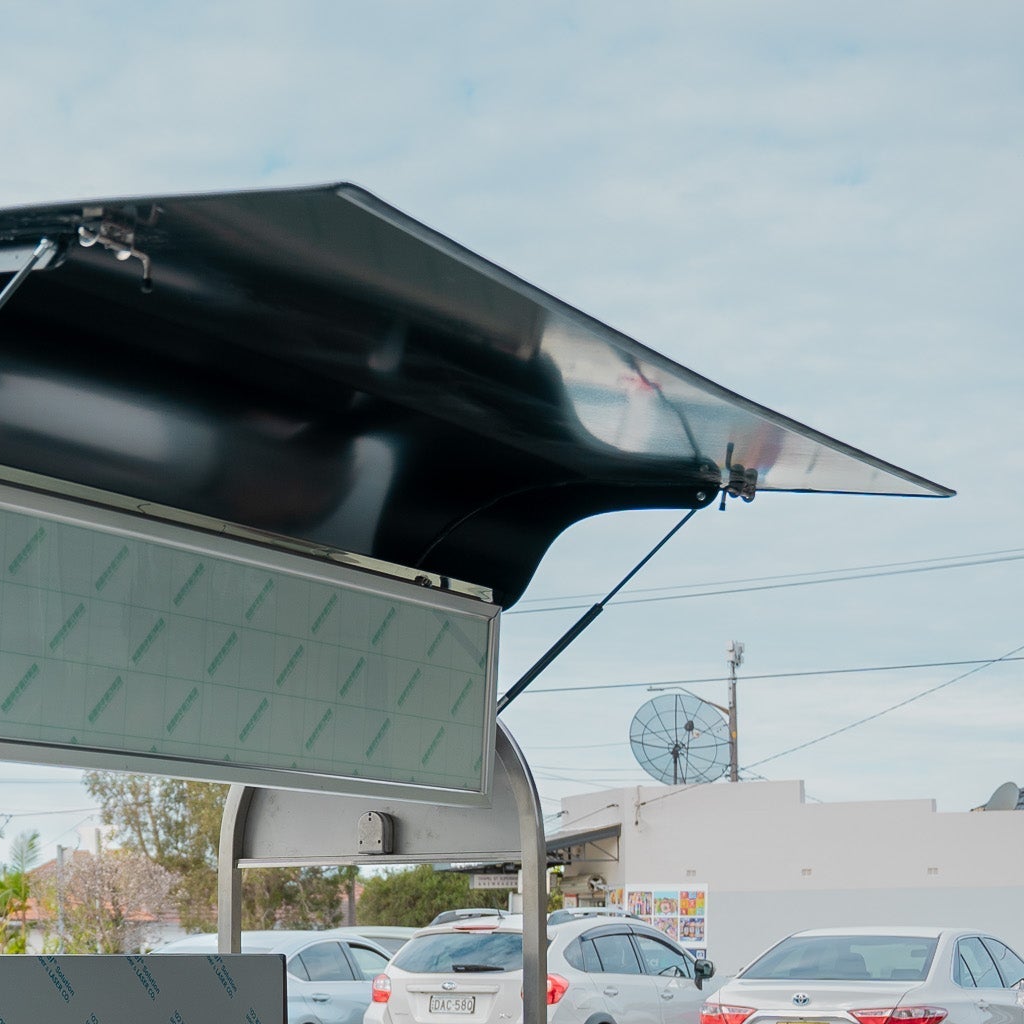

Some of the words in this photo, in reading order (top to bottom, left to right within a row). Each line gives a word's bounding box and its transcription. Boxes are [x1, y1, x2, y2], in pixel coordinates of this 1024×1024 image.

[48, 969, 63, 992] LASER
[56, 966, 75, 996] Solution
[136, 969, 149, 991] LASER
[142, 966, 160, 994] Solution
